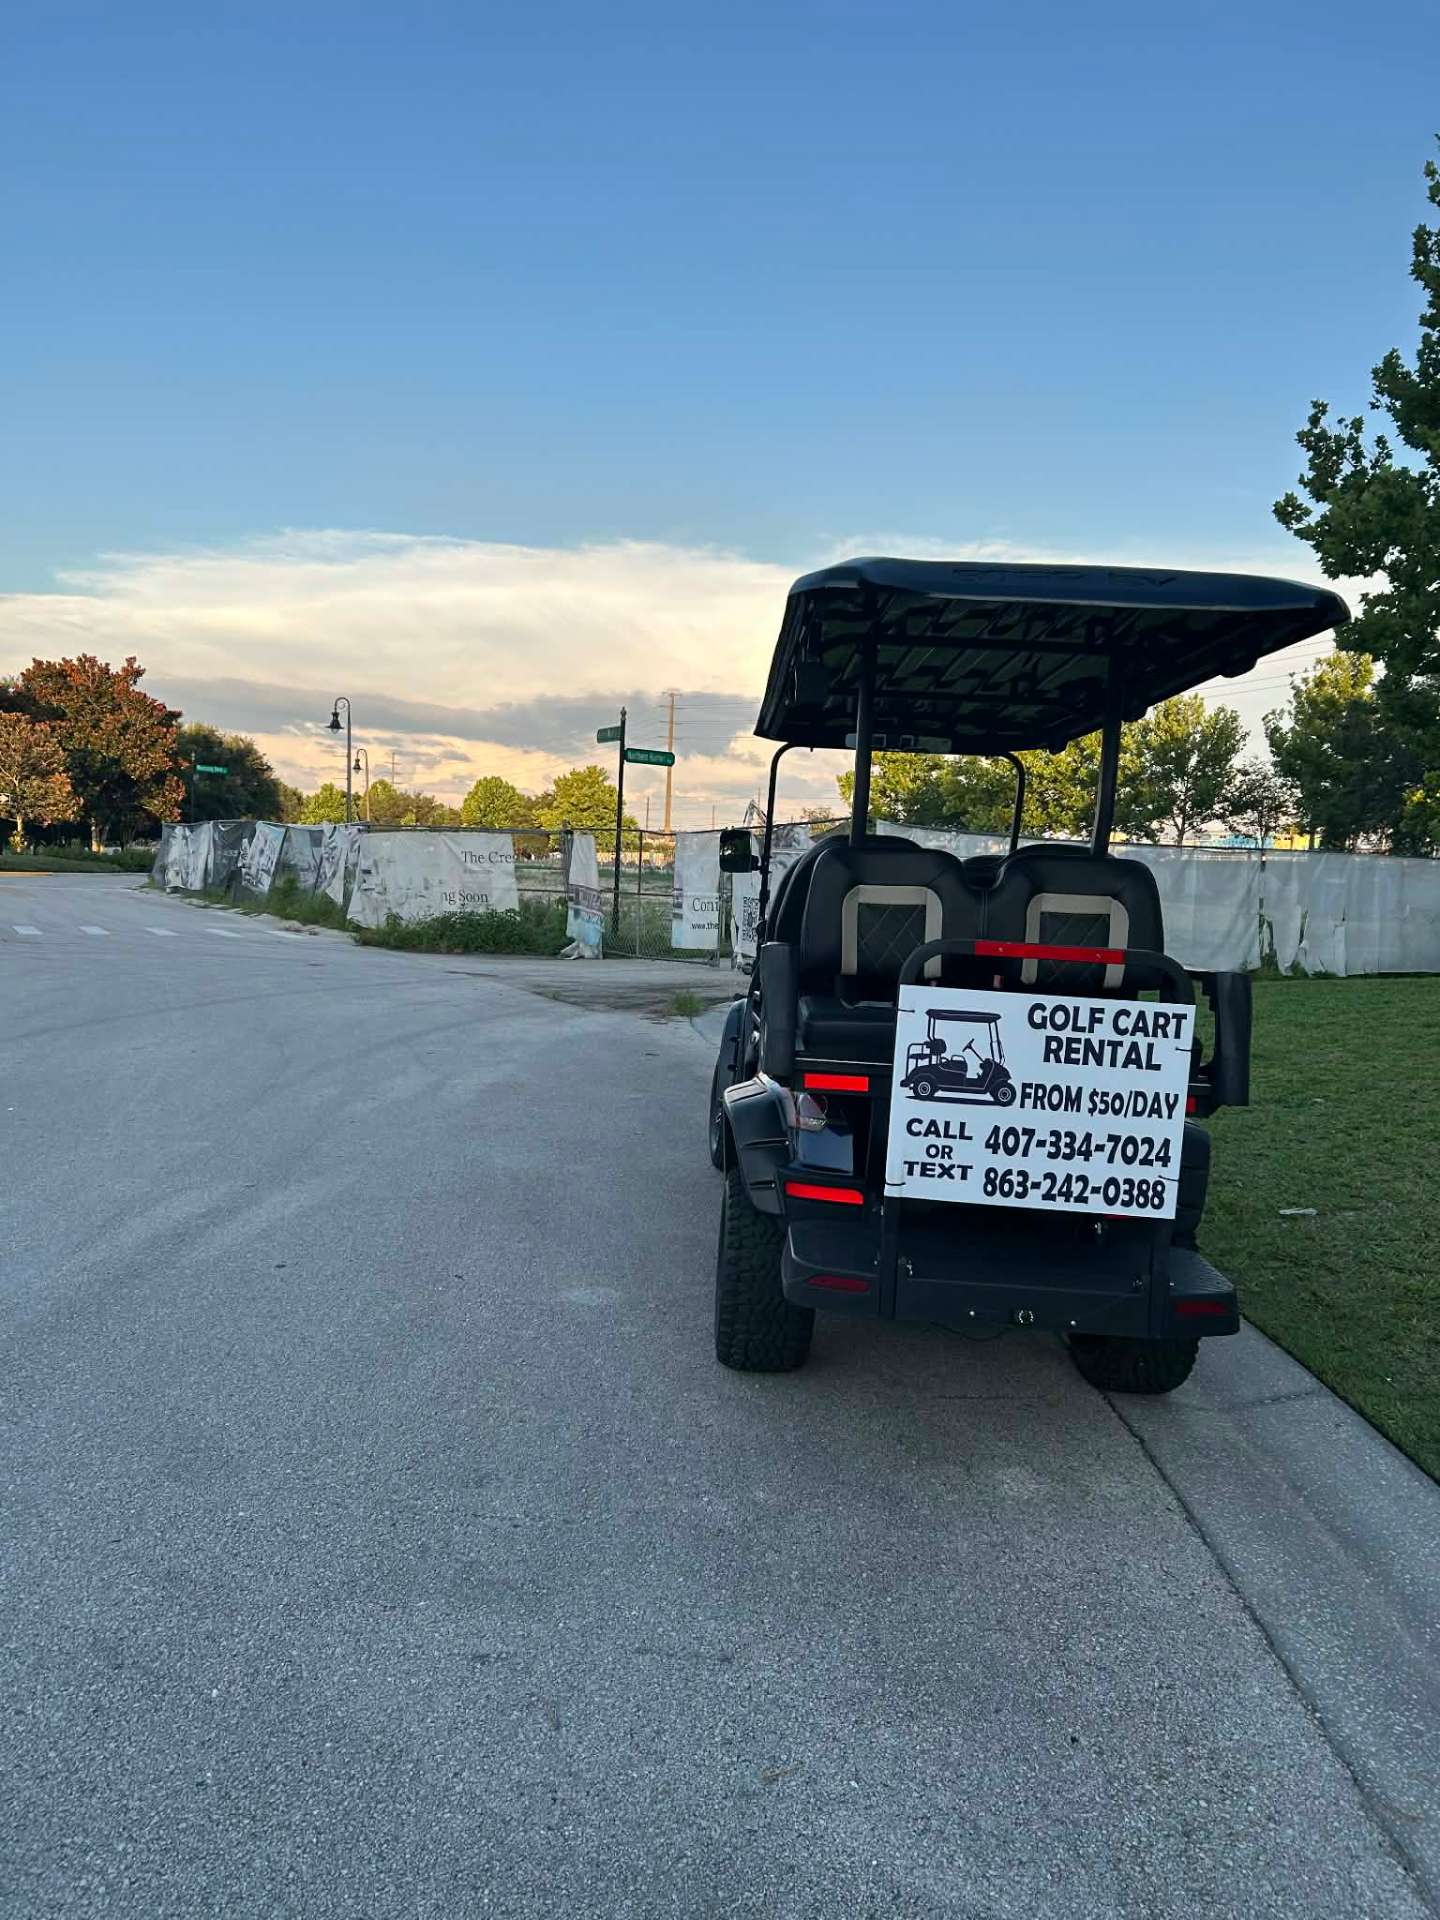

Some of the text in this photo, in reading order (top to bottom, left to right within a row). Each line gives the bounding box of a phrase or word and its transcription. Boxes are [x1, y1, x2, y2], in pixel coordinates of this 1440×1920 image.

[461, 850, 485, 864] The
[458, 888, 489, 903] Soon
[1027, 1002, 1188, 1040] GOLF CART
[1043, 1035, 1162, 1071] RENTAL
[1019, 1082, 1179, 1119] FROM $50/DAY
[906, 1117, 973, 1140] CALL
[925, 1143, 954, 1160] OR
[984, 1124, 1171, 1168] 407-334-7024
[903, 1160, 974, 1181] TEXT
[983, 1167, 1166, 1210] 863-242-0388
